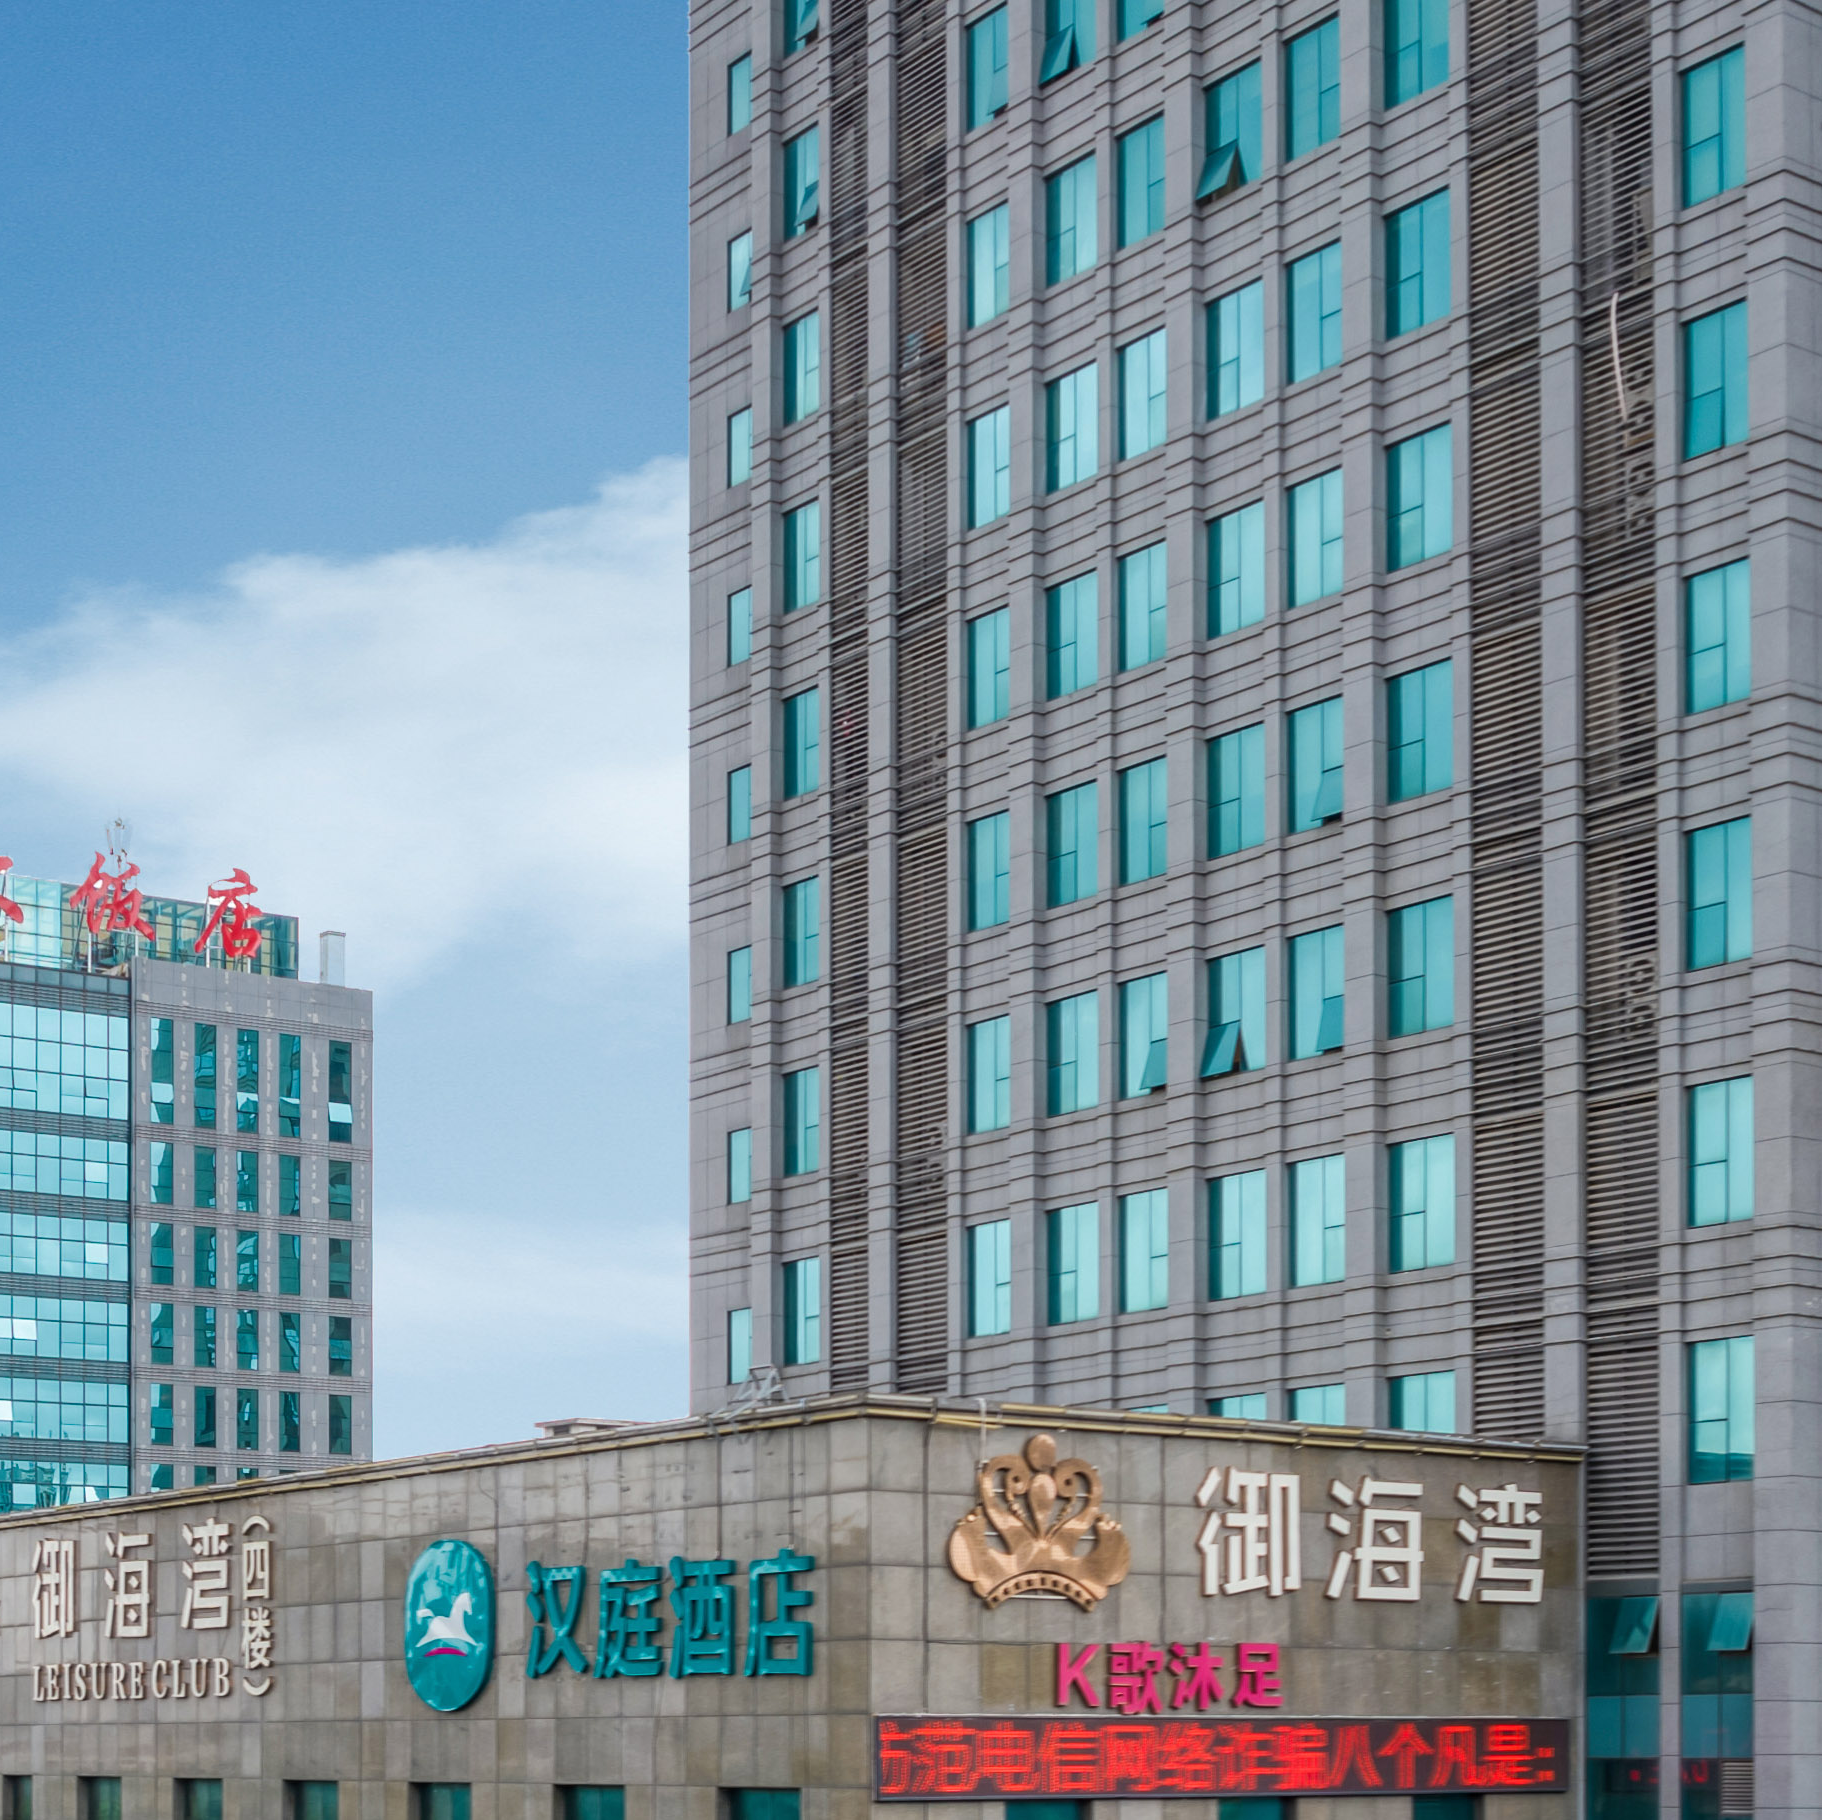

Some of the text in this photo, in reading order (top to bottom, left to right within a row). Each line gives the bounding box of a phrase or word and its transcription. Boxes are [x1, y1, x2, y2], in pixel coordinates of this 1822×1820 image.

[32, 1517, 230, 1639] 御海湾
[1196, 1465, 1545, 1603] 御海湾
[525, 1548, 816, 1680] 汉庭酒店
[33, 1657, 231, 1701] LEISURE CLUB
[1056, 1641, 1284, 1715] K歌沐足
